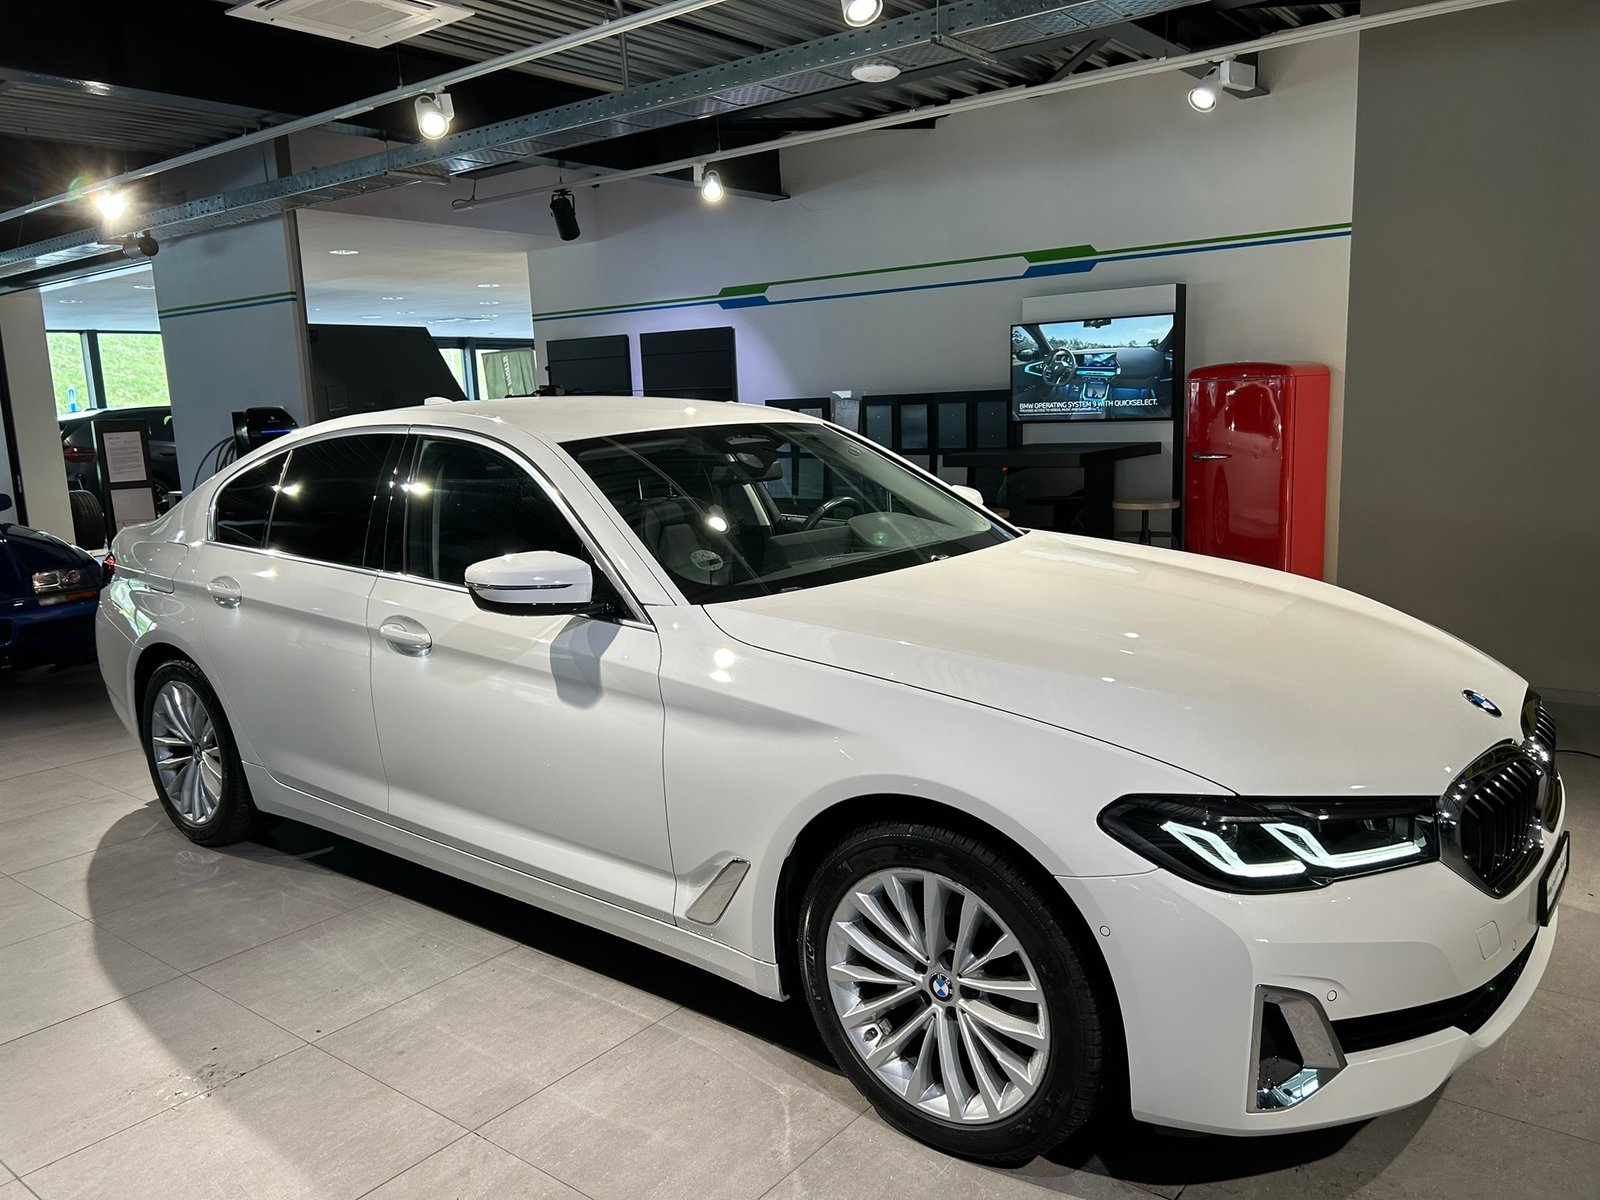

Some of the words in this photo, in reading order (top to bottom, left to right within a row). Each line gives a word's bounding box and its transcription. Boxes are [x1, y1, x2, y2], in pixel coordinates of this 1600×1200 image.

[1019, 402, 1034, 410] BMW
[1034, 401, 1067, 409] OPERATING
[1067, 400, 1092, 408] SYSTEM
[1114, 398, 1158, 407] QUICKSELECT.
